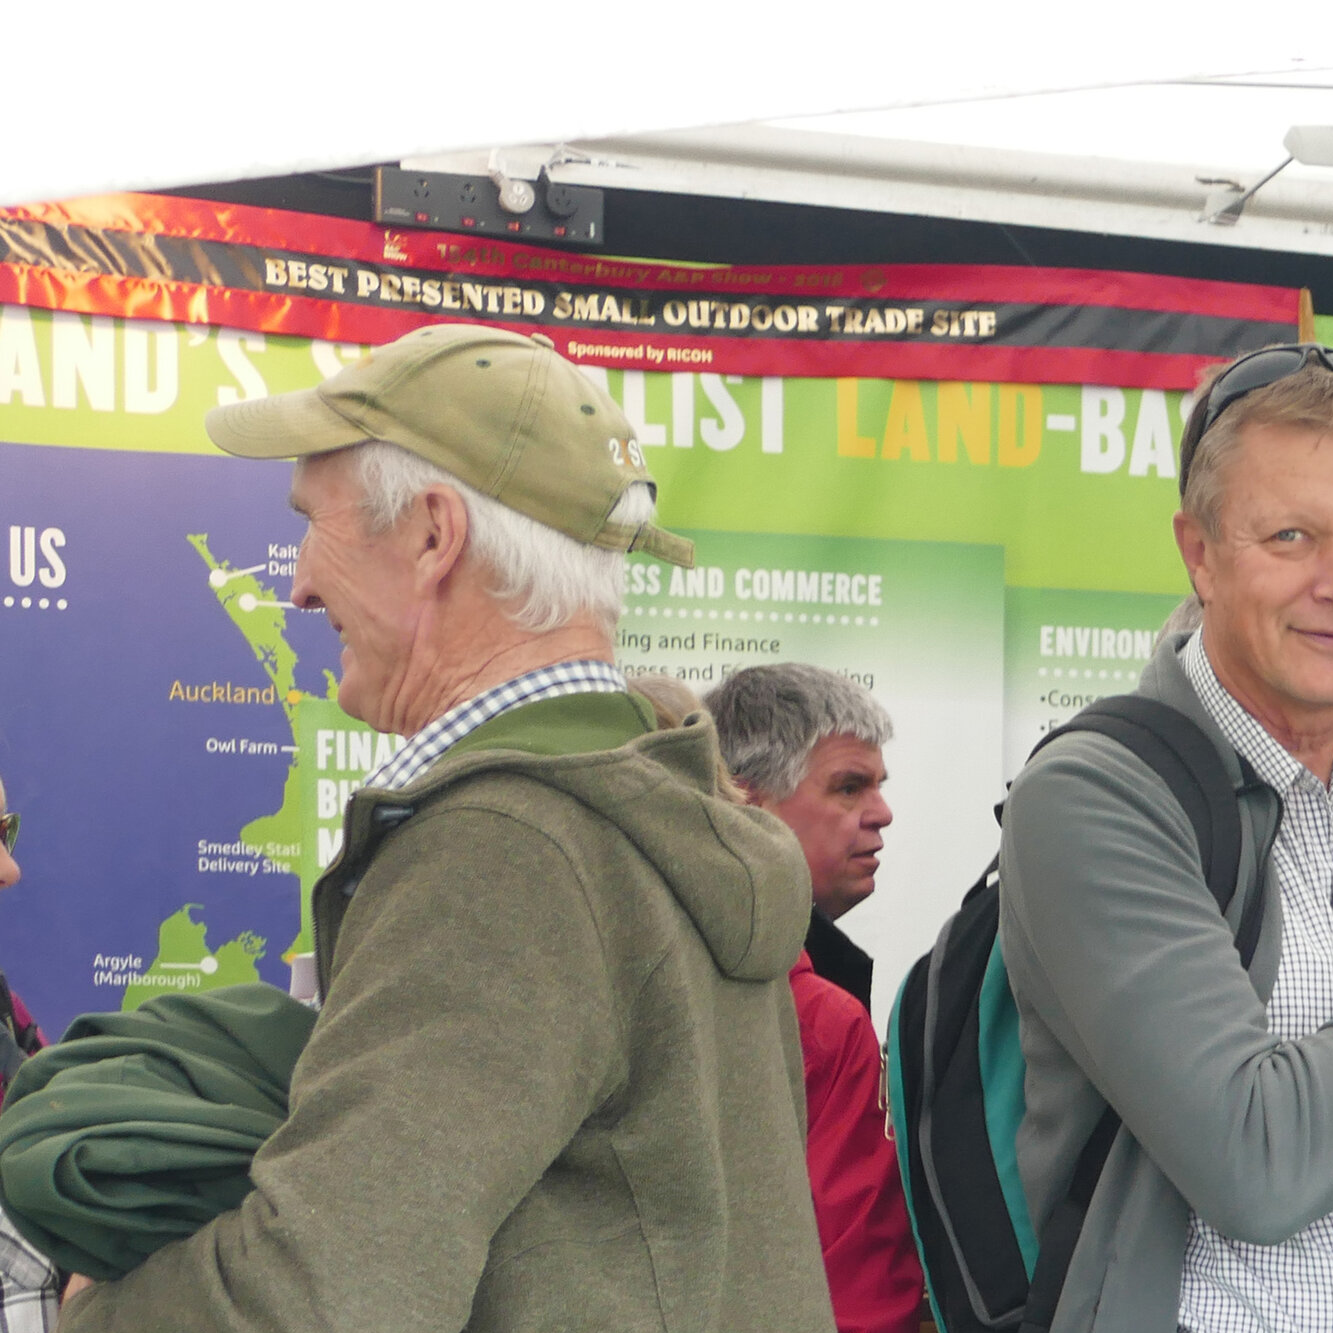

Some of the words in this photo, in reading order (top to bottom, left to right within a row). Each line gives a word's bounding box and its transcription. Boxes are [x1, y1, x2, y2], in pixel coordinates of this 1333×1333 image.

[513, 252, 651, 283] Canterbury
[266, 257, 348, 294] BEST
[357, 270, 546, 317] PRESENTED
[553, 291, 656, 327] SMALL
[662, 299, 819, 333] OUTDOOR
[825, 305, 924, 335] TRADE
[930, 308, 997, 337] SITE
[567, 340, 644, 359] Sponsored
[646, 344, 664, 364] by
[666, 346, 713, 363] RICOH
[836, 376, 1193, 478] LAND-BA
[9, 525, 67, 589] US
[669, 566, 725, 599] AND
[734, 568, 883, 606] COMMERCE
[658, 632, 696, 651] and
[703, 633, 780, 653] Finance
[676, 664, 714, 682] and
[169, 680, 275, 705] Auckland
[205, 737, 236, 754] Owl
[240, 738, 277, 755] Farm
[197, 839, 262, 860] Smedley
[198, 857, 258, 877] Delivery
[262, 859, 292, 874] Site
[93, 953, 142, 971] Argyle
[93, 971, 201, 990] (Marlborough)
